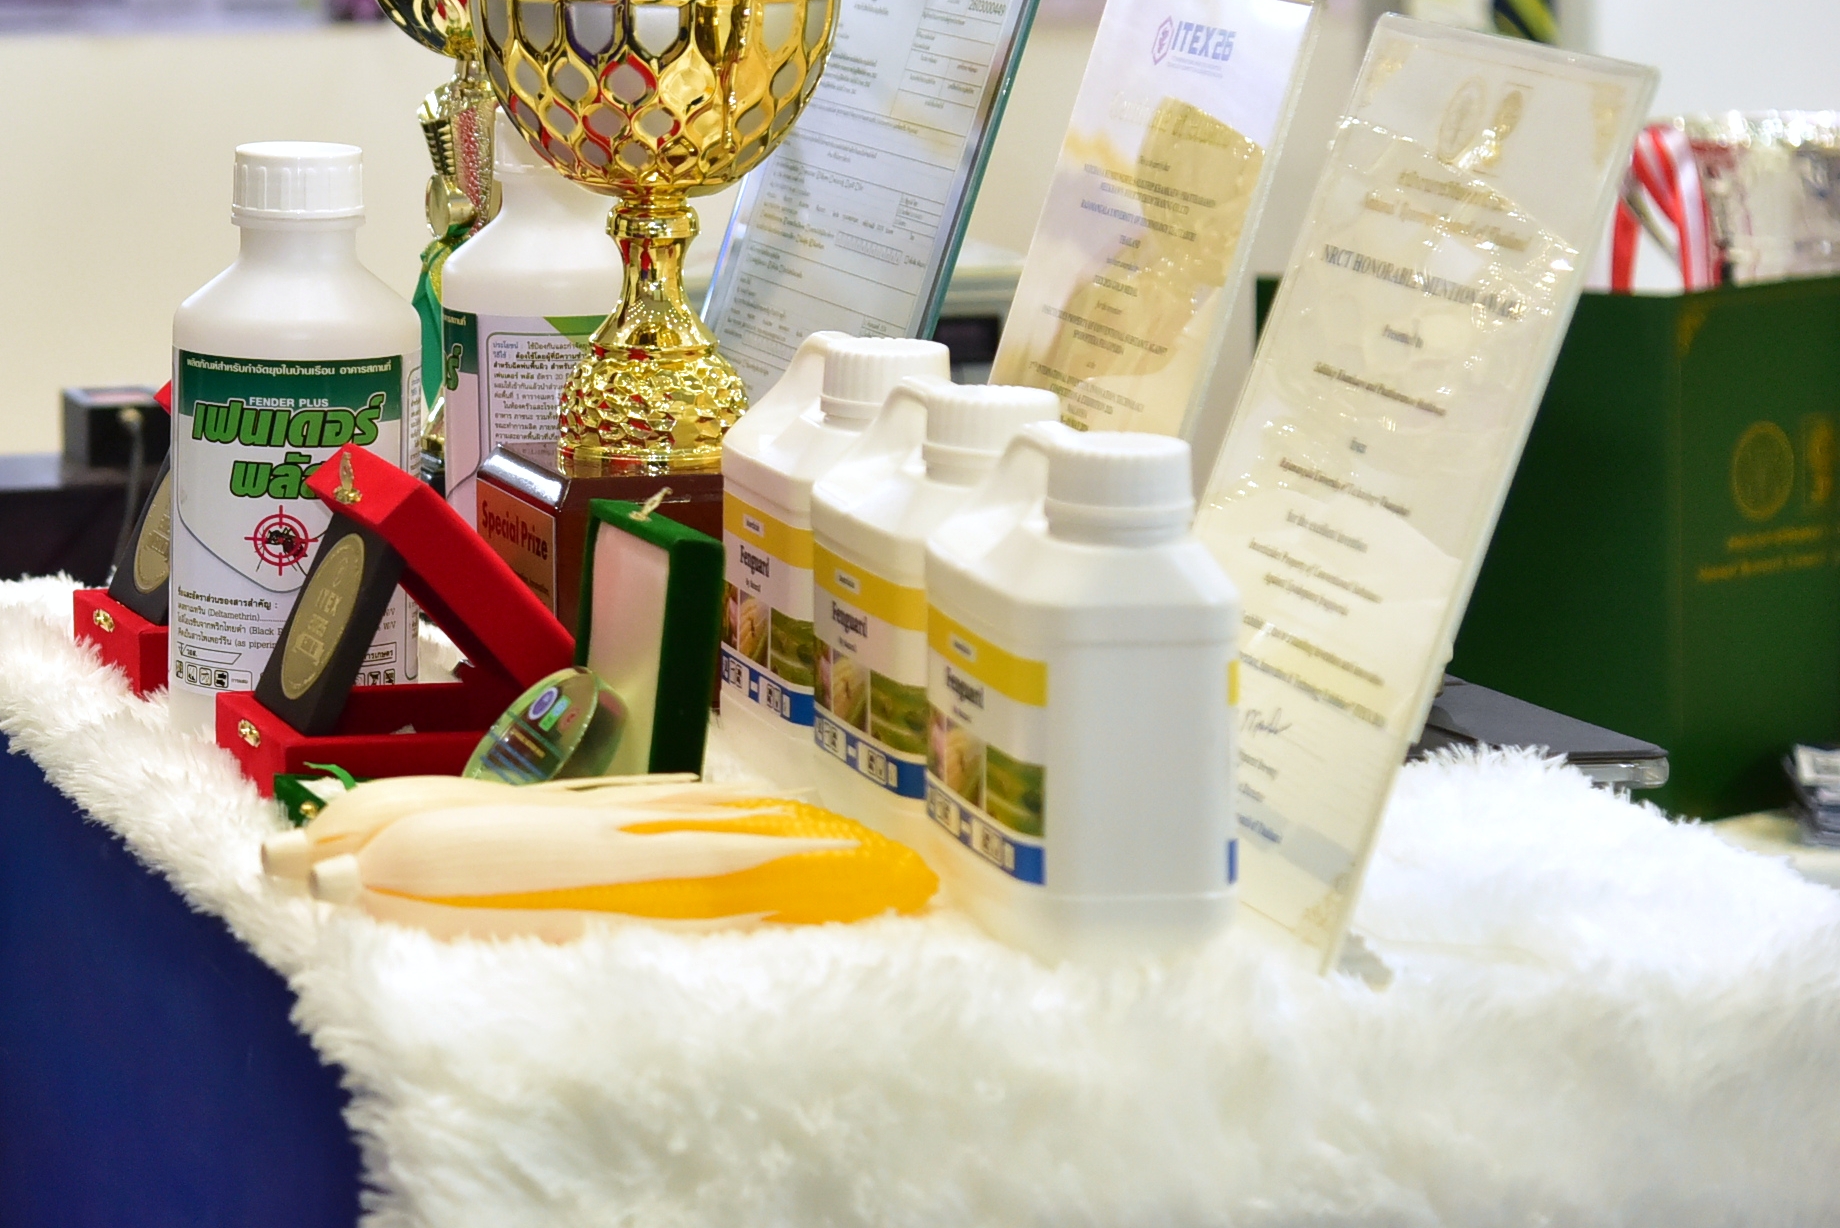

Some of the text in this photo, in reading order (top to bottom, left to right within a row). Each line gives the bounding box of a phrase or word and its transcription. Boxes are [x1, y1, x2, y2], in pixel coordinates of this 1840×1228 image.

[249, 396, 329, 408] FENDER PLUS
[481, 499, 549, 561] Special Prize
[249, 624, 275, 636] (Black
